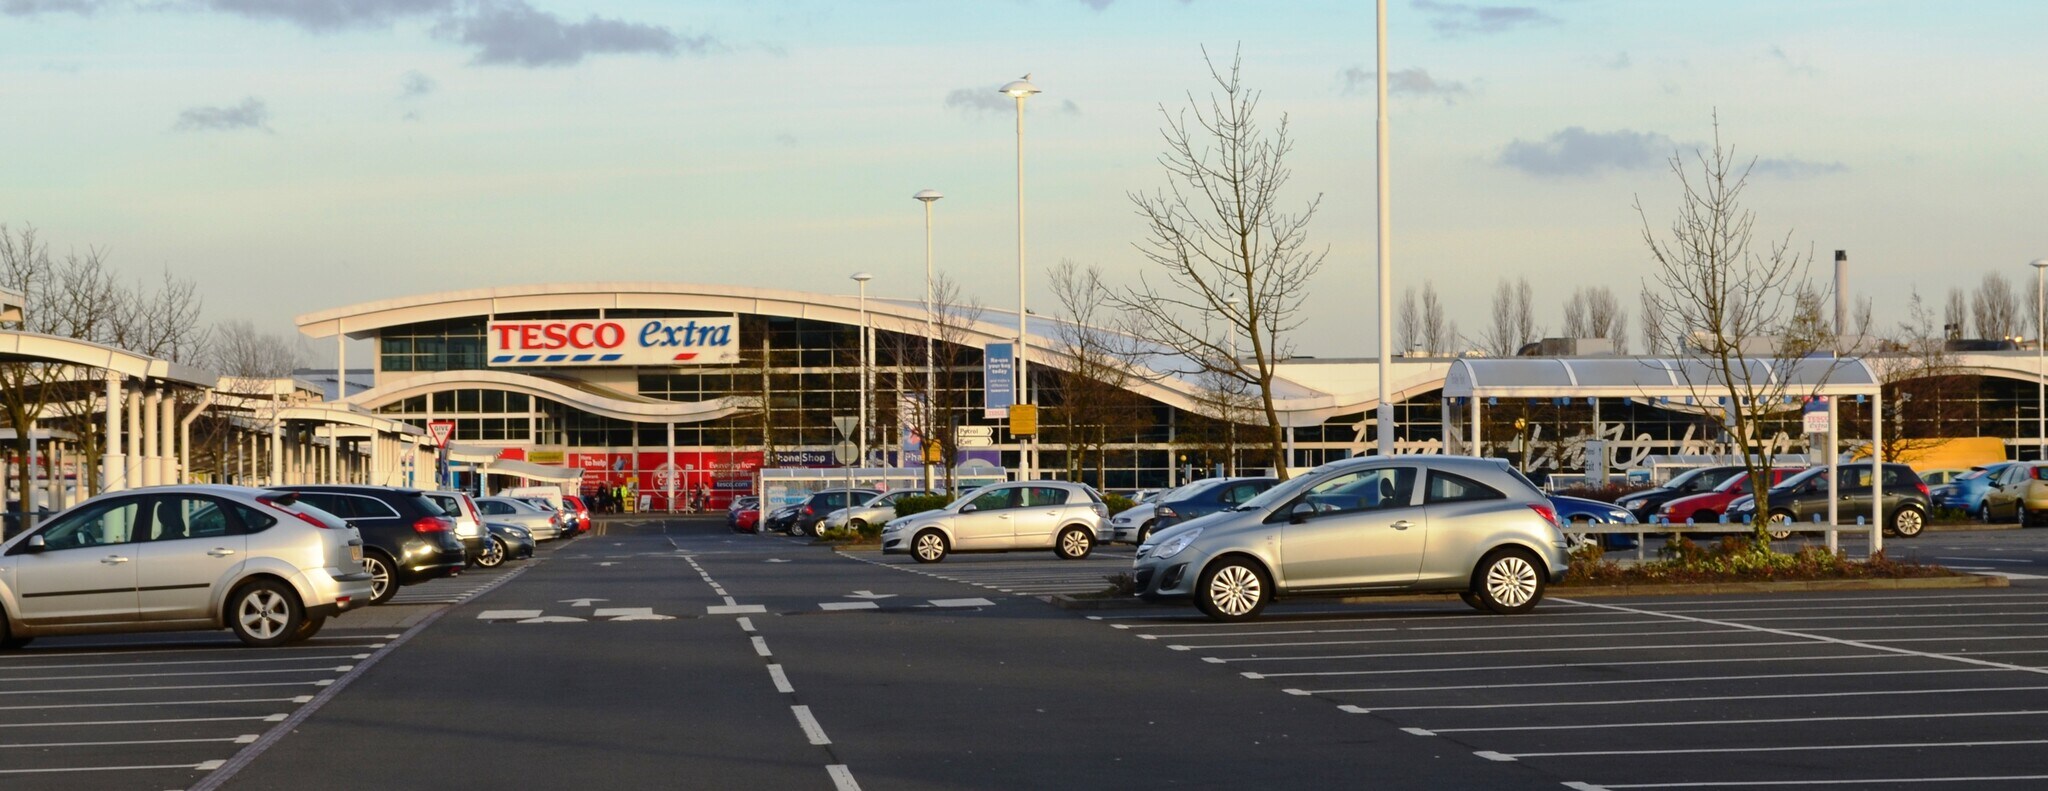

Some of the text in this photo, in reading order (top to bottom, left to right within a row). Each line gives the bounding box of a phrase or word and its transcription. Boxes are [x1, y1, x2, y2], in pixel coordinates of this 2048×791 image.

[490, 320, 732, 349] TESCO extra
[592, 459, 607, 468] help
[802, 453, 826, 464] Shop
